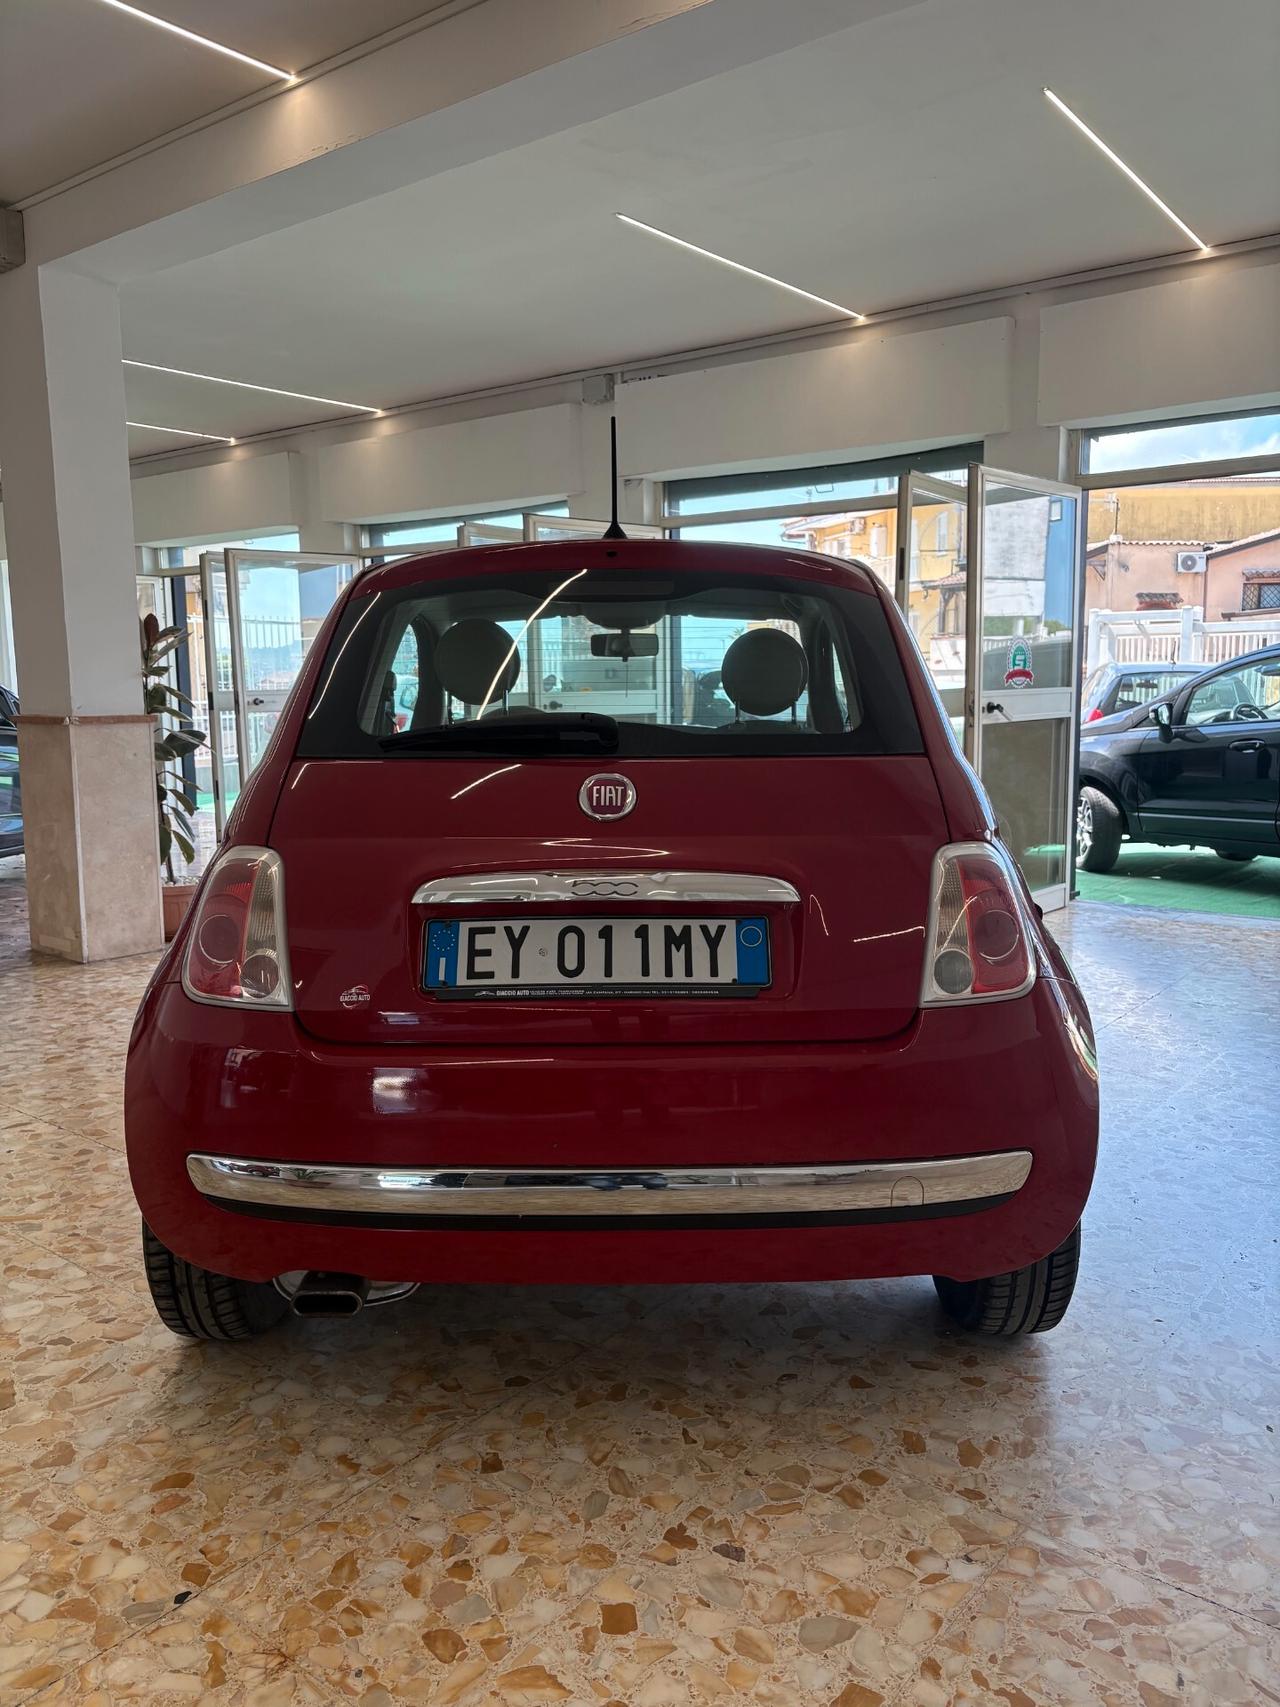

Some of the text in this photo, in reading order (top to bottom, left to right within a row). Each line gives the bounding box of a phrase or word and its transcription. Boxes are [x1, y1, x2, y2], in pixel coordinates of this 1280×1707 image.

[592, 785, 625, 807] FIAT
[571, 880, 639, 896] 500
[466, 924, 727, 980] EY 011MY
[438, 957, 446, 981] I
